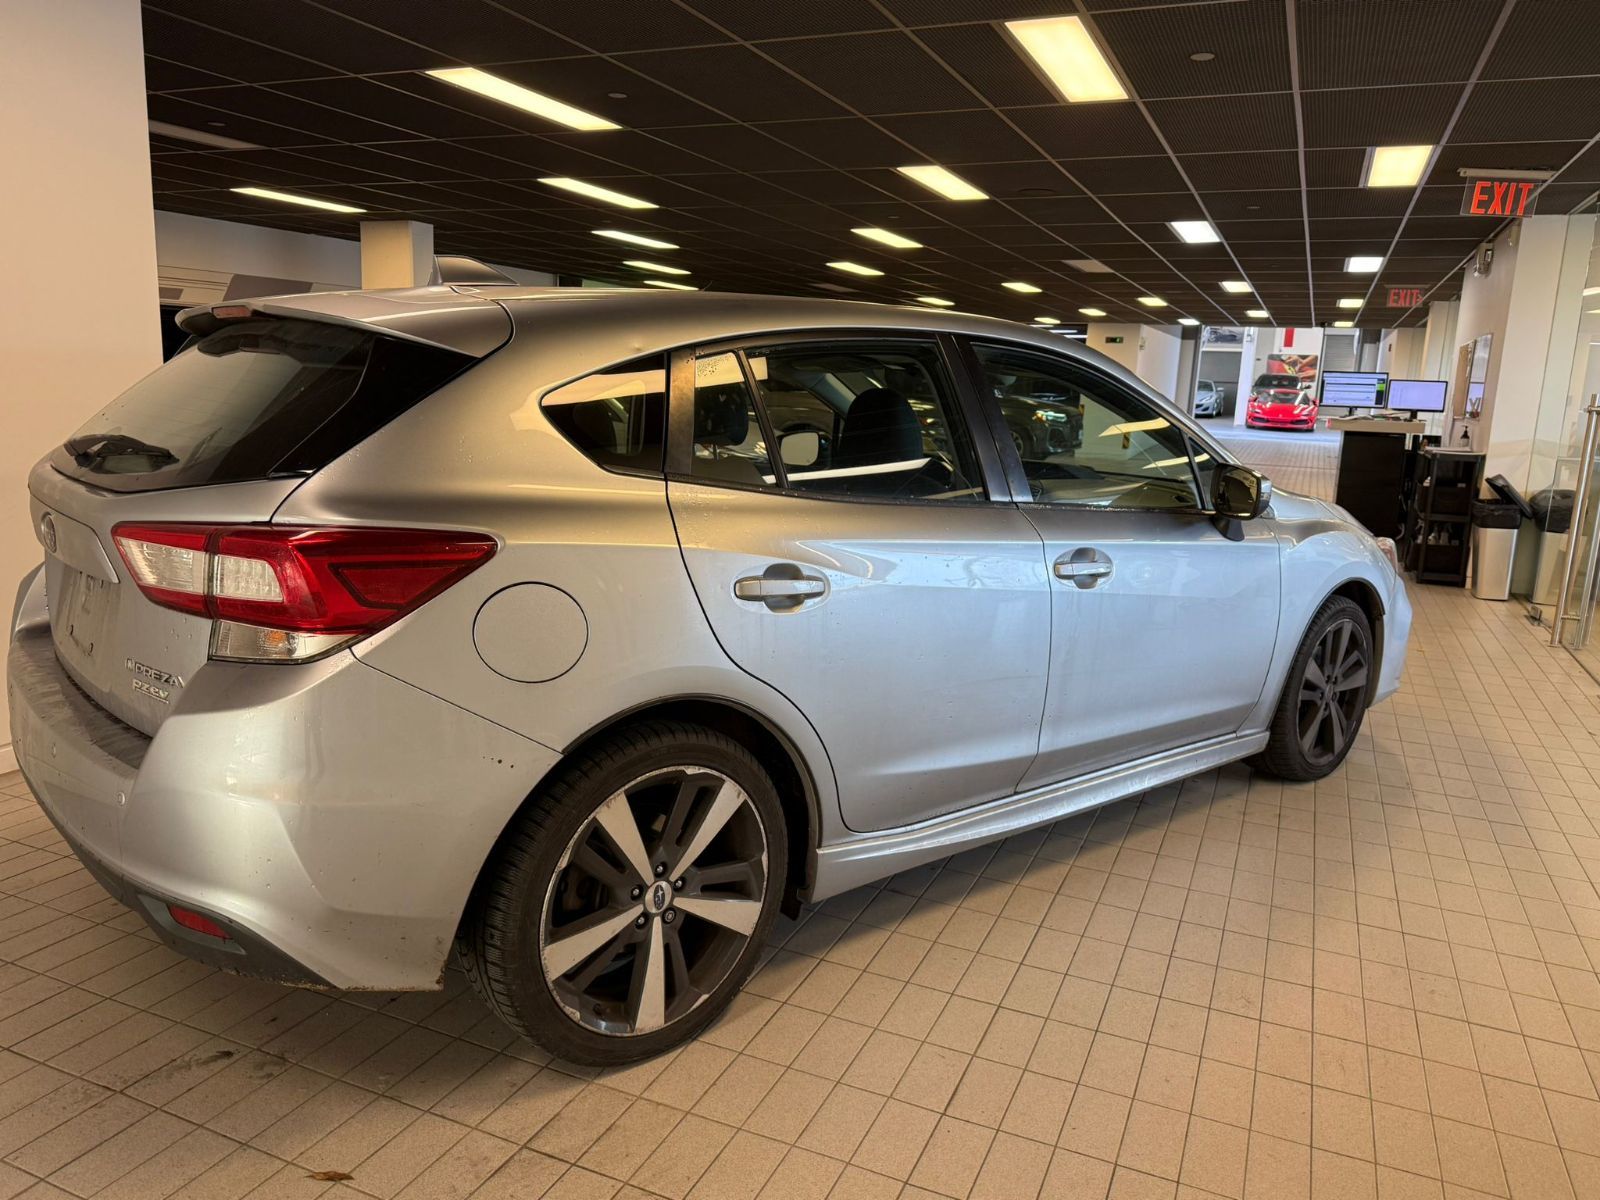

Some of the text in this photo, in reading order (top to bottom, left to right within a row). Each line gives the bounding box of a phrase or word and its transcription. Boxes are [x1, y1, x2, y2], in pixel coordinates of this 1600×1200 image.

[1470, 181, 1534, 216] EXIT
[1389, 288, 1419, 305] EXIT
[125, 658, 185, 688] IMPREZA
